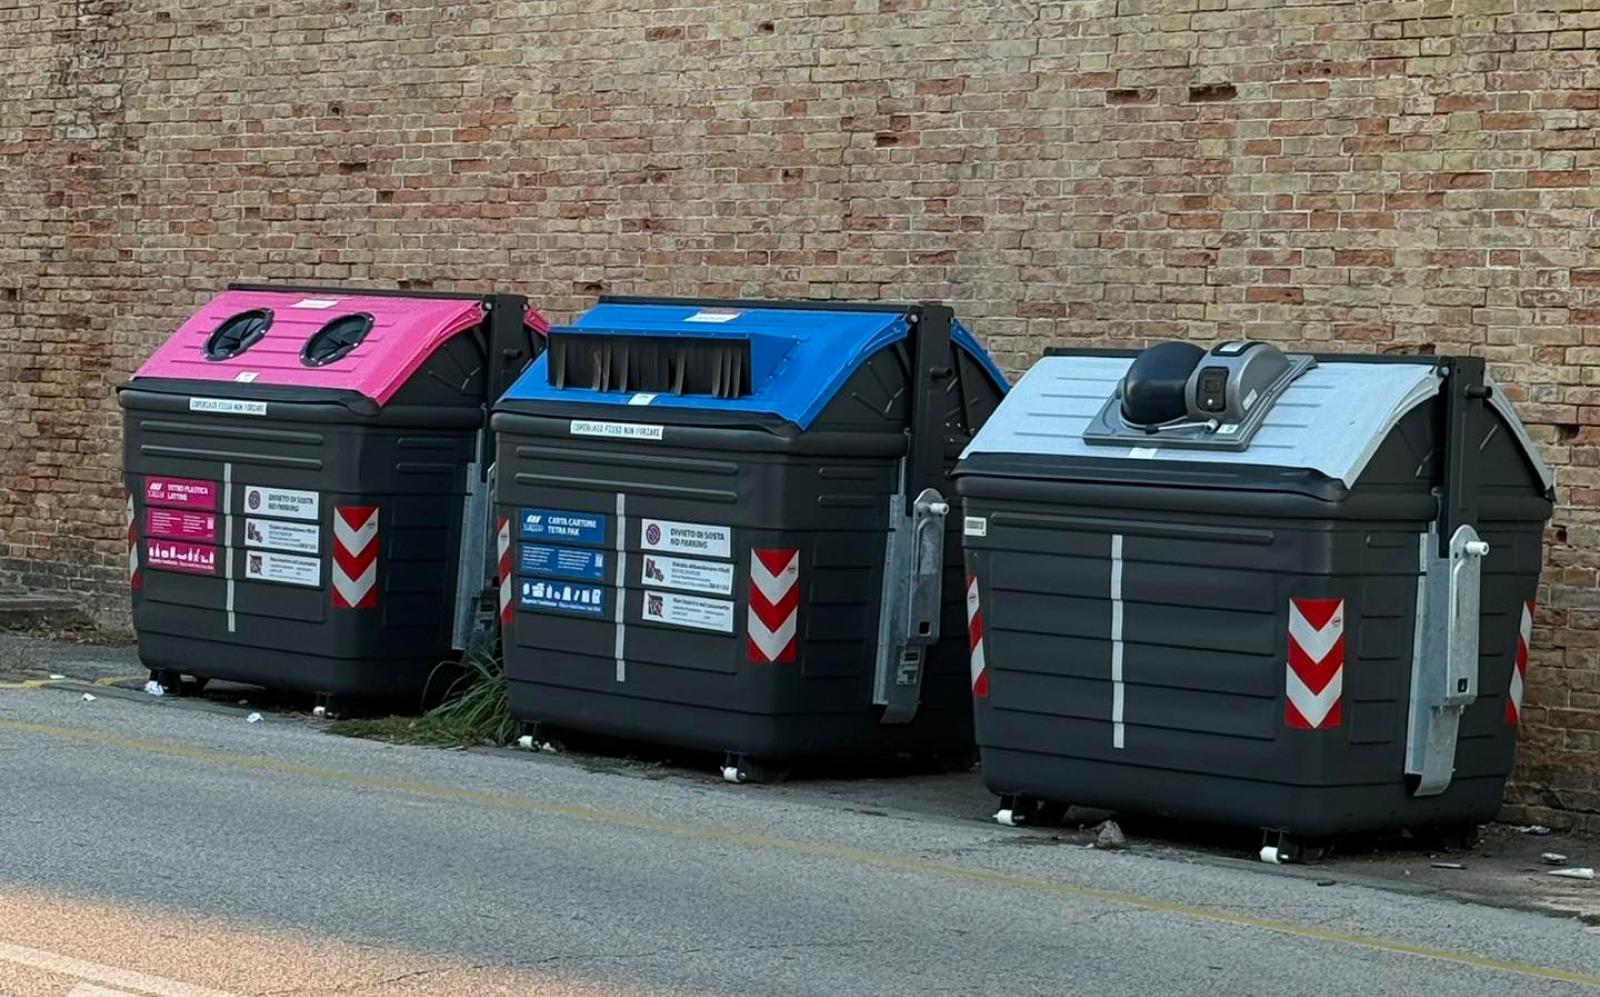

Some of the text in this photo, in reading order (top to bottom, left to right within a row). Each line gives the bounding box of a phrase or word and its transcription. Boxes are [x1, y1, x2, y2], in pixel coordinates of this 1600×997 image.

[548, 516, 568, 526] CARTA
[569, 519, 597, 529] CARTONE
[548, 526, 580, 536] TETRA PAK
[671, 528, 725, 541] DIVIETO DI SOSTA
[670, 538, 708, 549] NO PARKING
